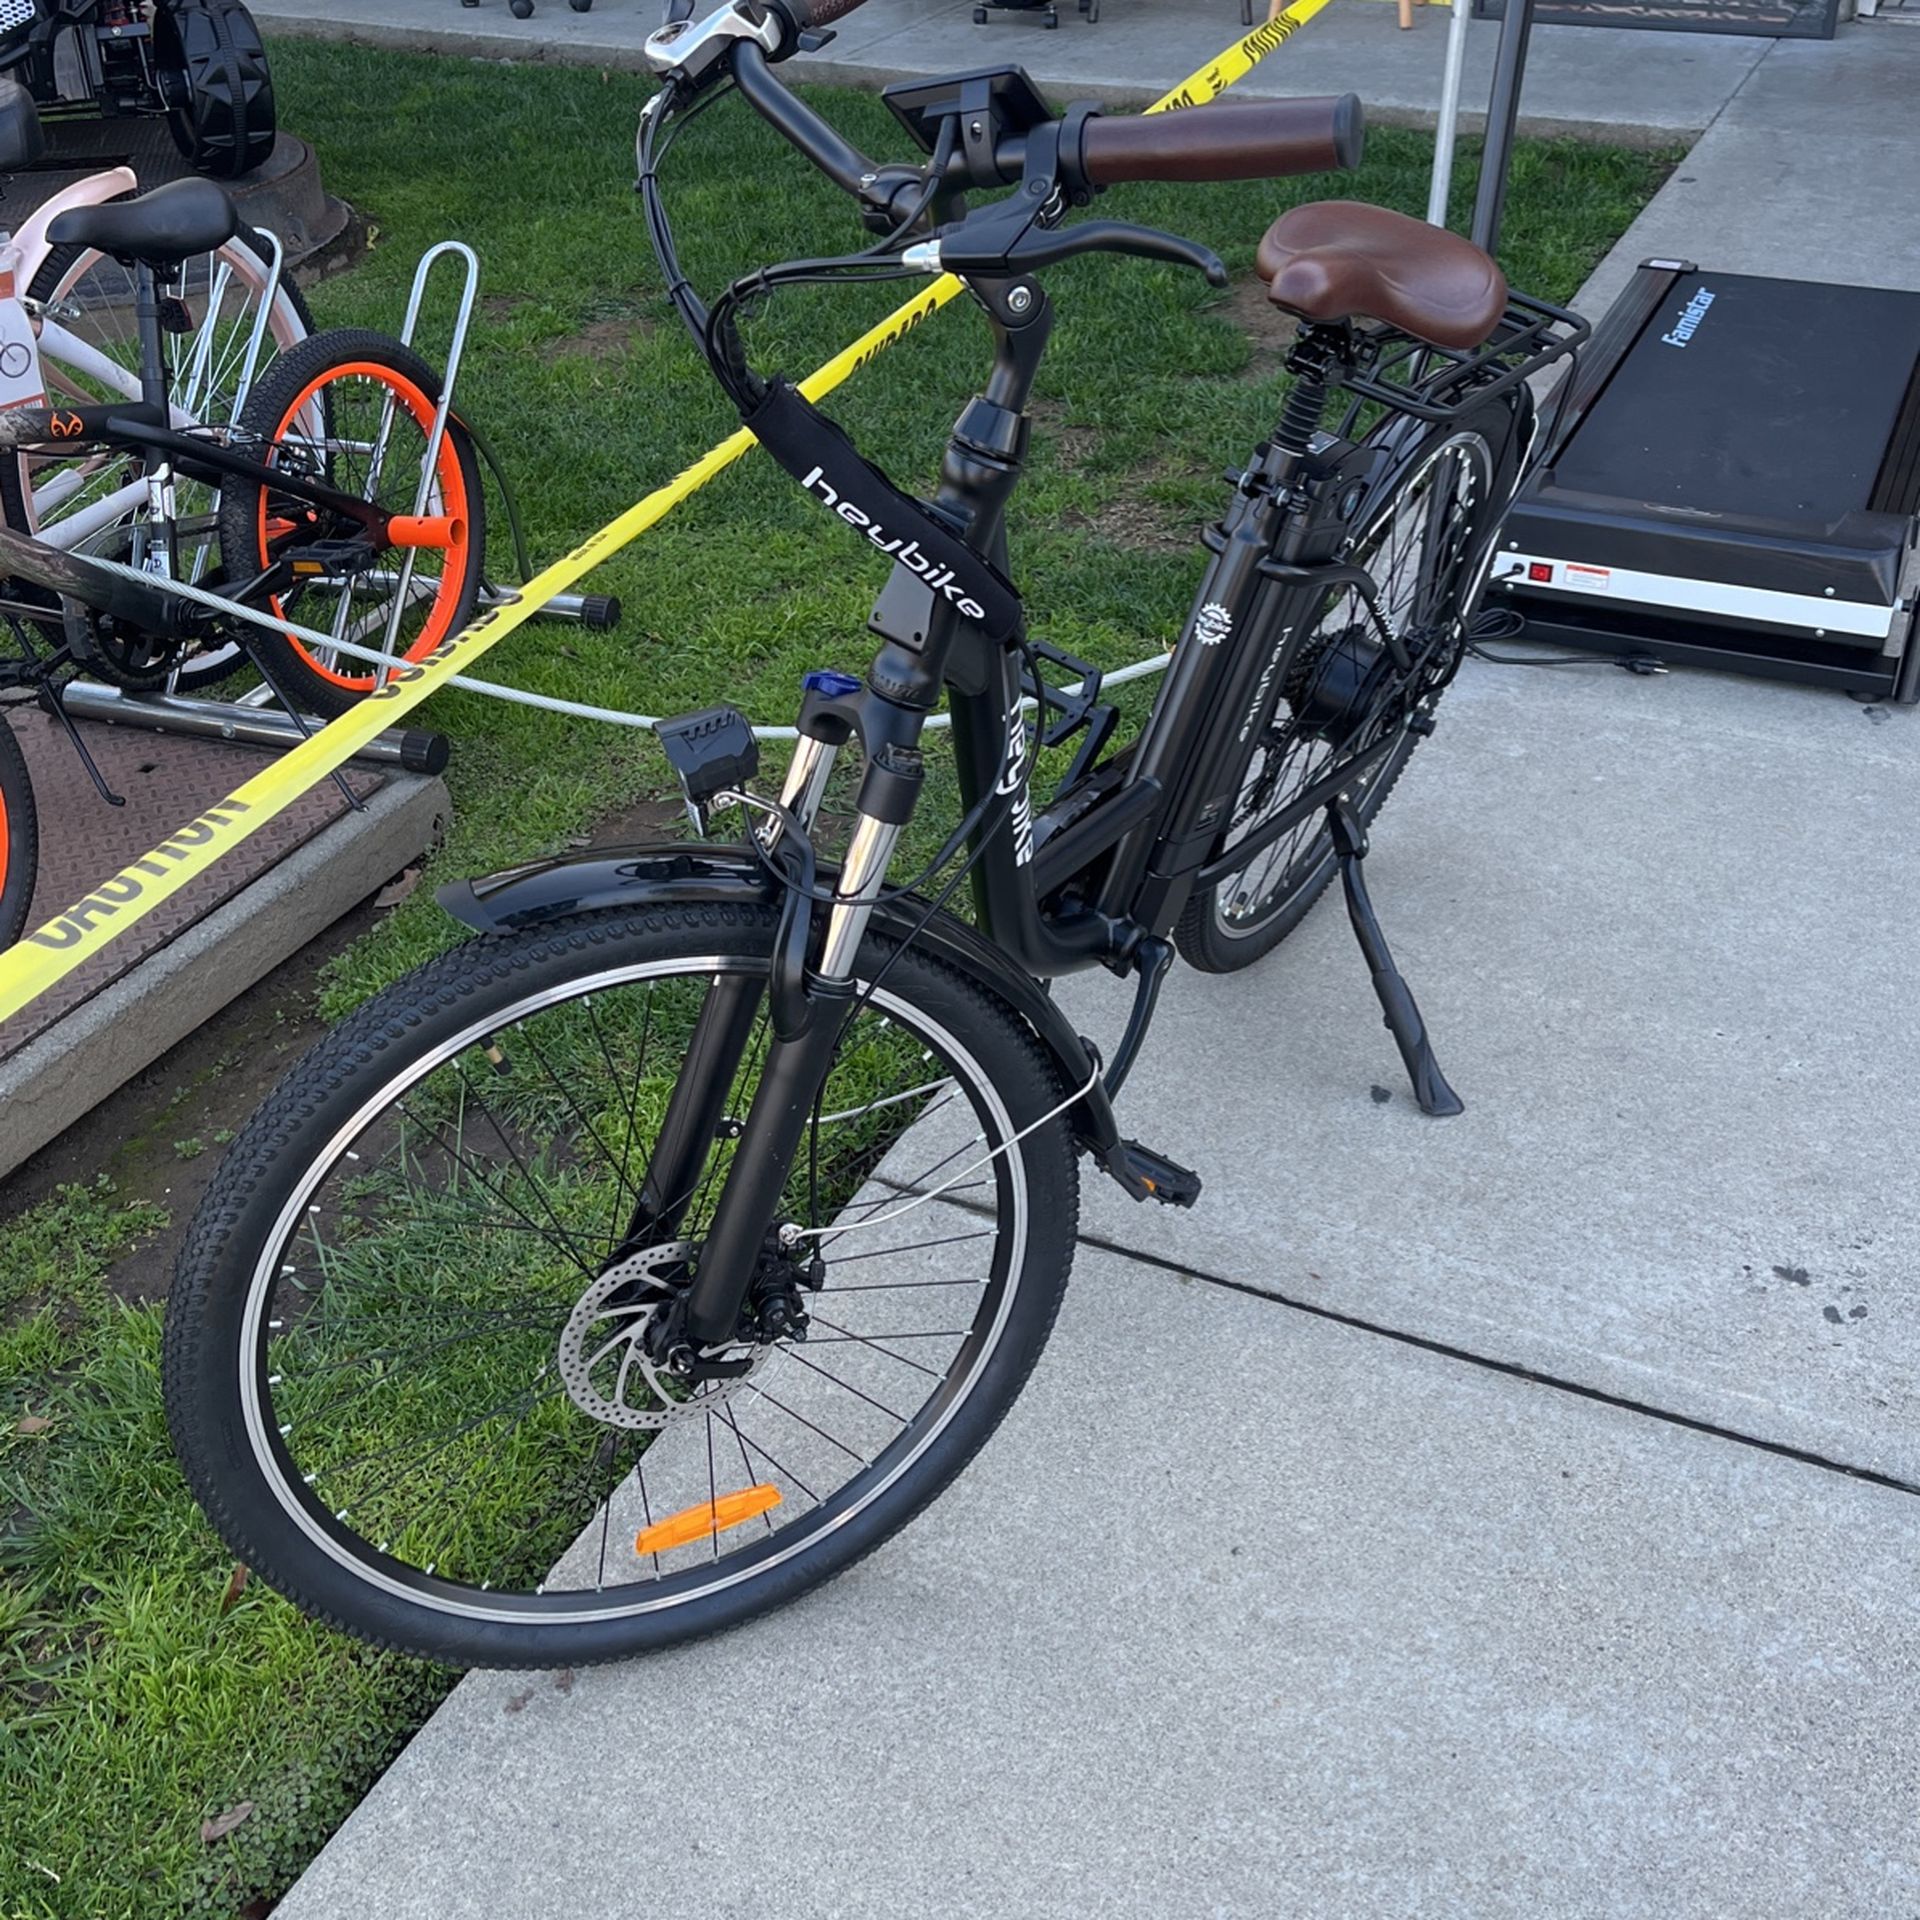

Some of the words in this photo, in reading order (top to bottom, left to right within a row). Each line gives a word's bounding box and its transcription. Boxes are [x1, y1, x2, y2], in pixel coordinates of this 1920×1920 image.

[1661, 286, 1716, 348] Famistar
[801, 466, 985, 619] heybike
[1238, 626, 1294, 743] heybike
